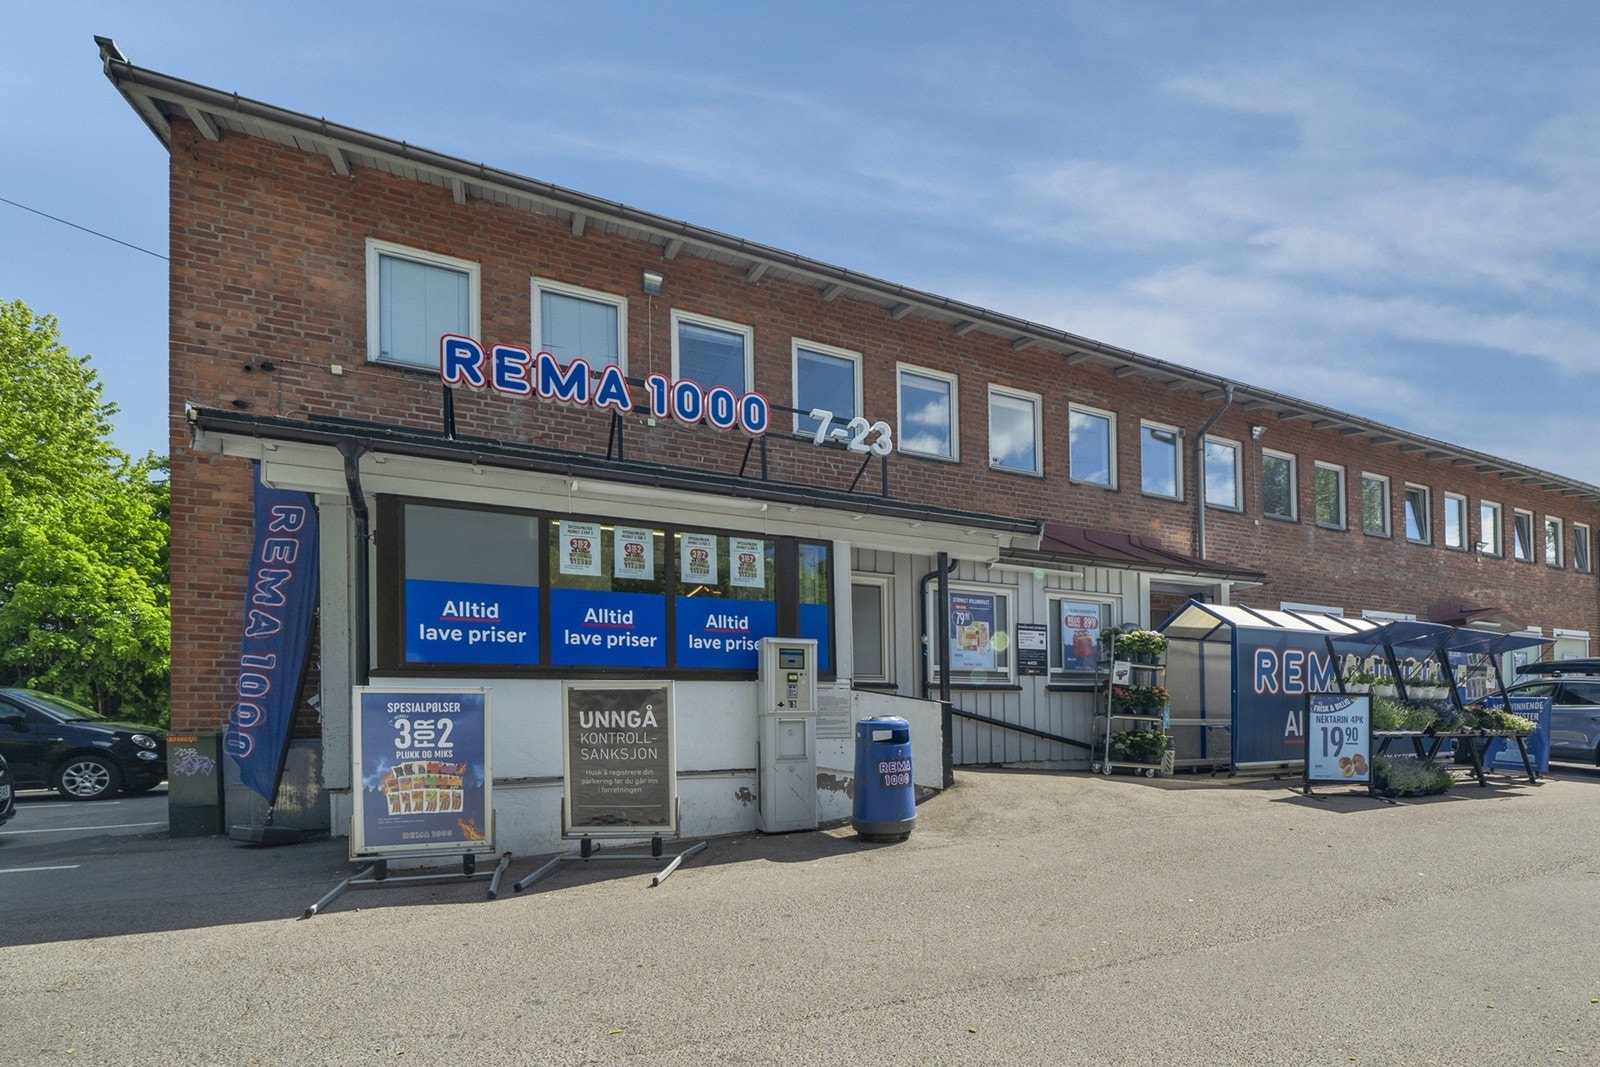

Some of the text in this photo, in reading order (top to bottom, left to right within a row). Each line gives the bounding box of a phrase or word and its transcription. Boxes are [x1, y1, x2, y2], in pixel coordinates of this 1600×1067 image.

[439, 333, 769, 437] REMA 1000
[809, 408, 893, 457] 7-23
[245, 504, 306, 637] REMA
[442, 600, 499, 619] Alltid
[583, 607, 634, 625] Alltid
[705, 613, 749, 630] Alltid
[419, 624, 527, 644] lave priser
[564, 630, 657, 649] lave priser
[688, 634, 760, 652] lave prise
[387, 702, 461, 713] SPESIALPØLSER
[580, 704, 658, 728] UNNGÅ
[1313, 704, 1329, 713] FRISK
[1316, 716, 1348, 724] NEKTARIN
[394, 718, 454, 749] 3 FOR 2
[580, 732, 657, 744] KONTROLL-
[396, 750, 453, 759] PLUKK OG MIKS
[581, 748, 658, 760] SANKSJON
[609, 770, 642, 778] registrere
[878, 760, 912, 774] REMA
